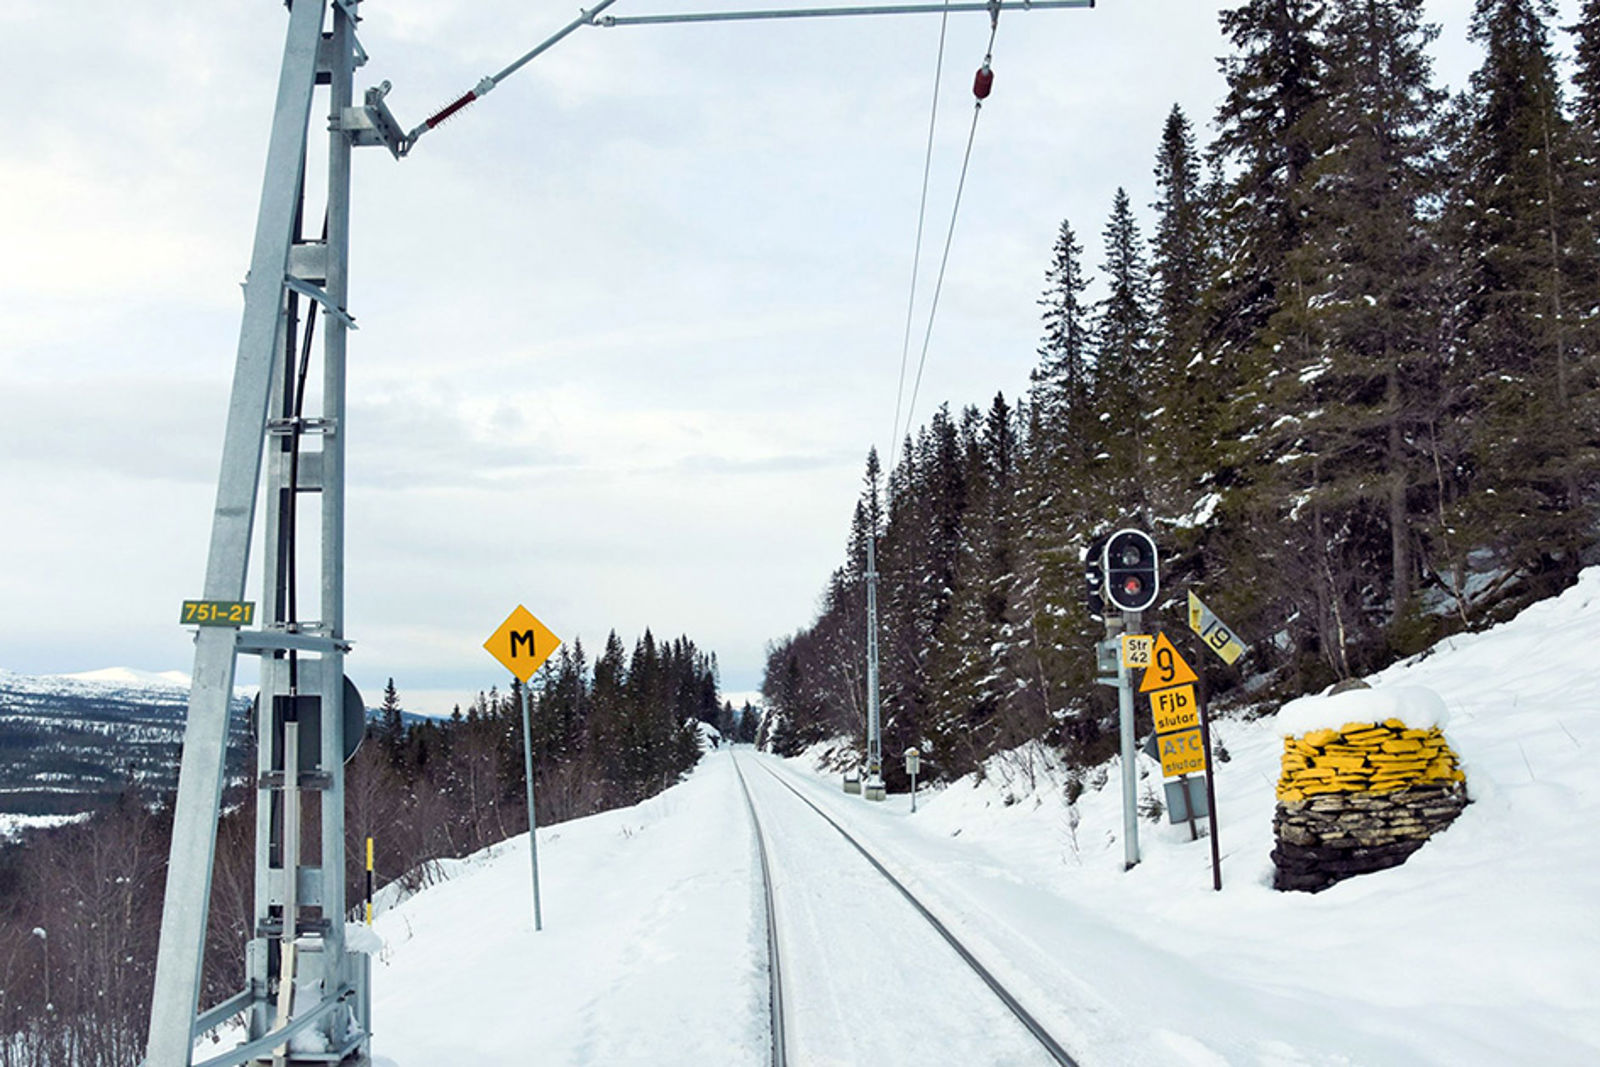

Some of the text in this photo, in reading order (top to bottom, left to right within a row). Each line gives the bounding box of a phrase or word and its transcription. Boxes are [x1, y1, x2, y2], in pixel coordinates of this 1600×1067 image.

[185, 603, 251, 622] 751-21
[510, 629, 535, 658] M
[1128, 639, 1148, 652] Str
[1130, 651, 1148, 663] 42
[1156, 648, 1175, 682] 9
[1159, 692, 1187, 713] Fjb
[1158, 713, 1195, 728] slutar
[1163, 734, 1200, 757] ATC
[1165, 758, 1203, 773] slutar
